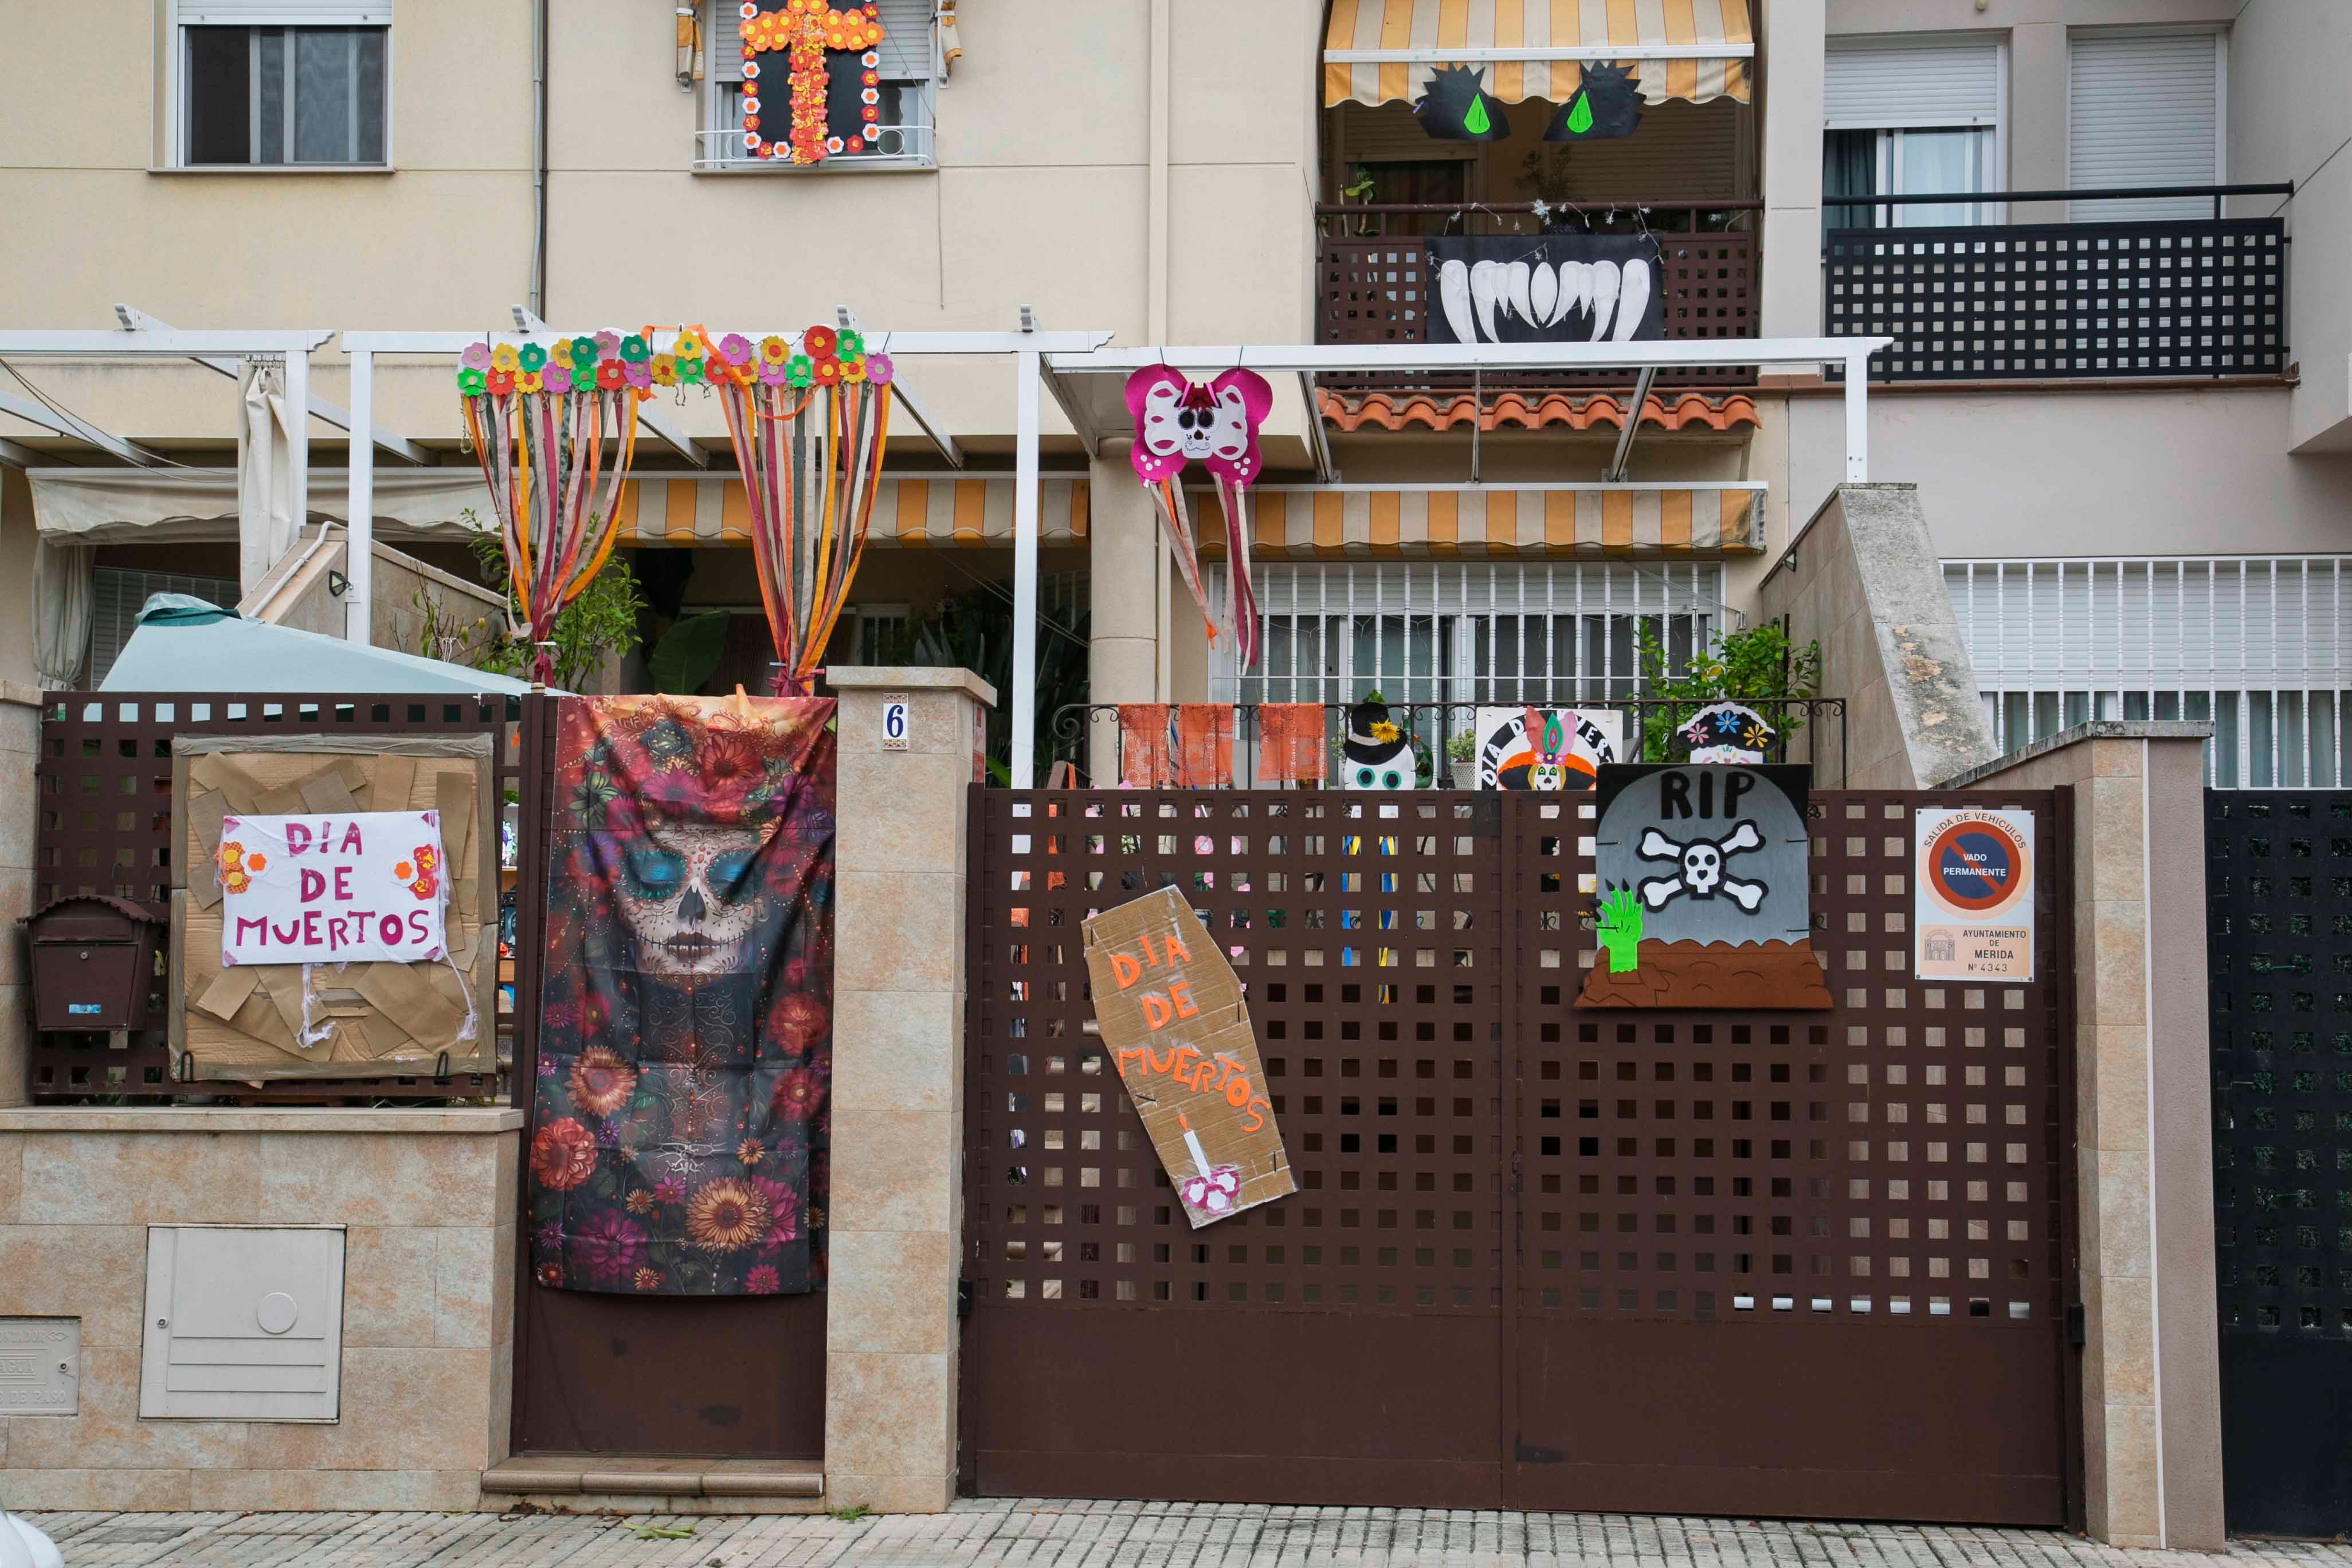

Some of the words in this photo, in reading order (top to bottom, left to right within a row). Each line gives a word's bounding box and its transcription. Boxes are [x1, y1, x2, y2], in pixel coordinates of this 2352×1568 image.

[887, 704, 904, 738] 6
[1481, 743, 1502, 786] DIA
[1660, 770, 1756, 820] RIP
[285, 821, 362, 857] DIA
[1924, 818, 1954, 848] SALIDA
[1956, 813, 1971, 822] DE
[1974, 812, 2026, 849] VEHICULOS
[1943, 867, 2006, 877] PERMANENTE
[1963, 853, 1988, 861] VADO
[300, 866, 354, 903] DE
[236, 909, 429, 951] MUERTOS
[1962, 930, 2026, 938] AYUNTAMIENTO
[1111, 935, 1191, 990] DIA
[1974, 950, 2014, 959] MERIDA
[1981, 963, 2008, 972] 4343
[1140, 980, 1199, 1031] DE
[1118, 1047, 1271, 1134] MUERTOS
